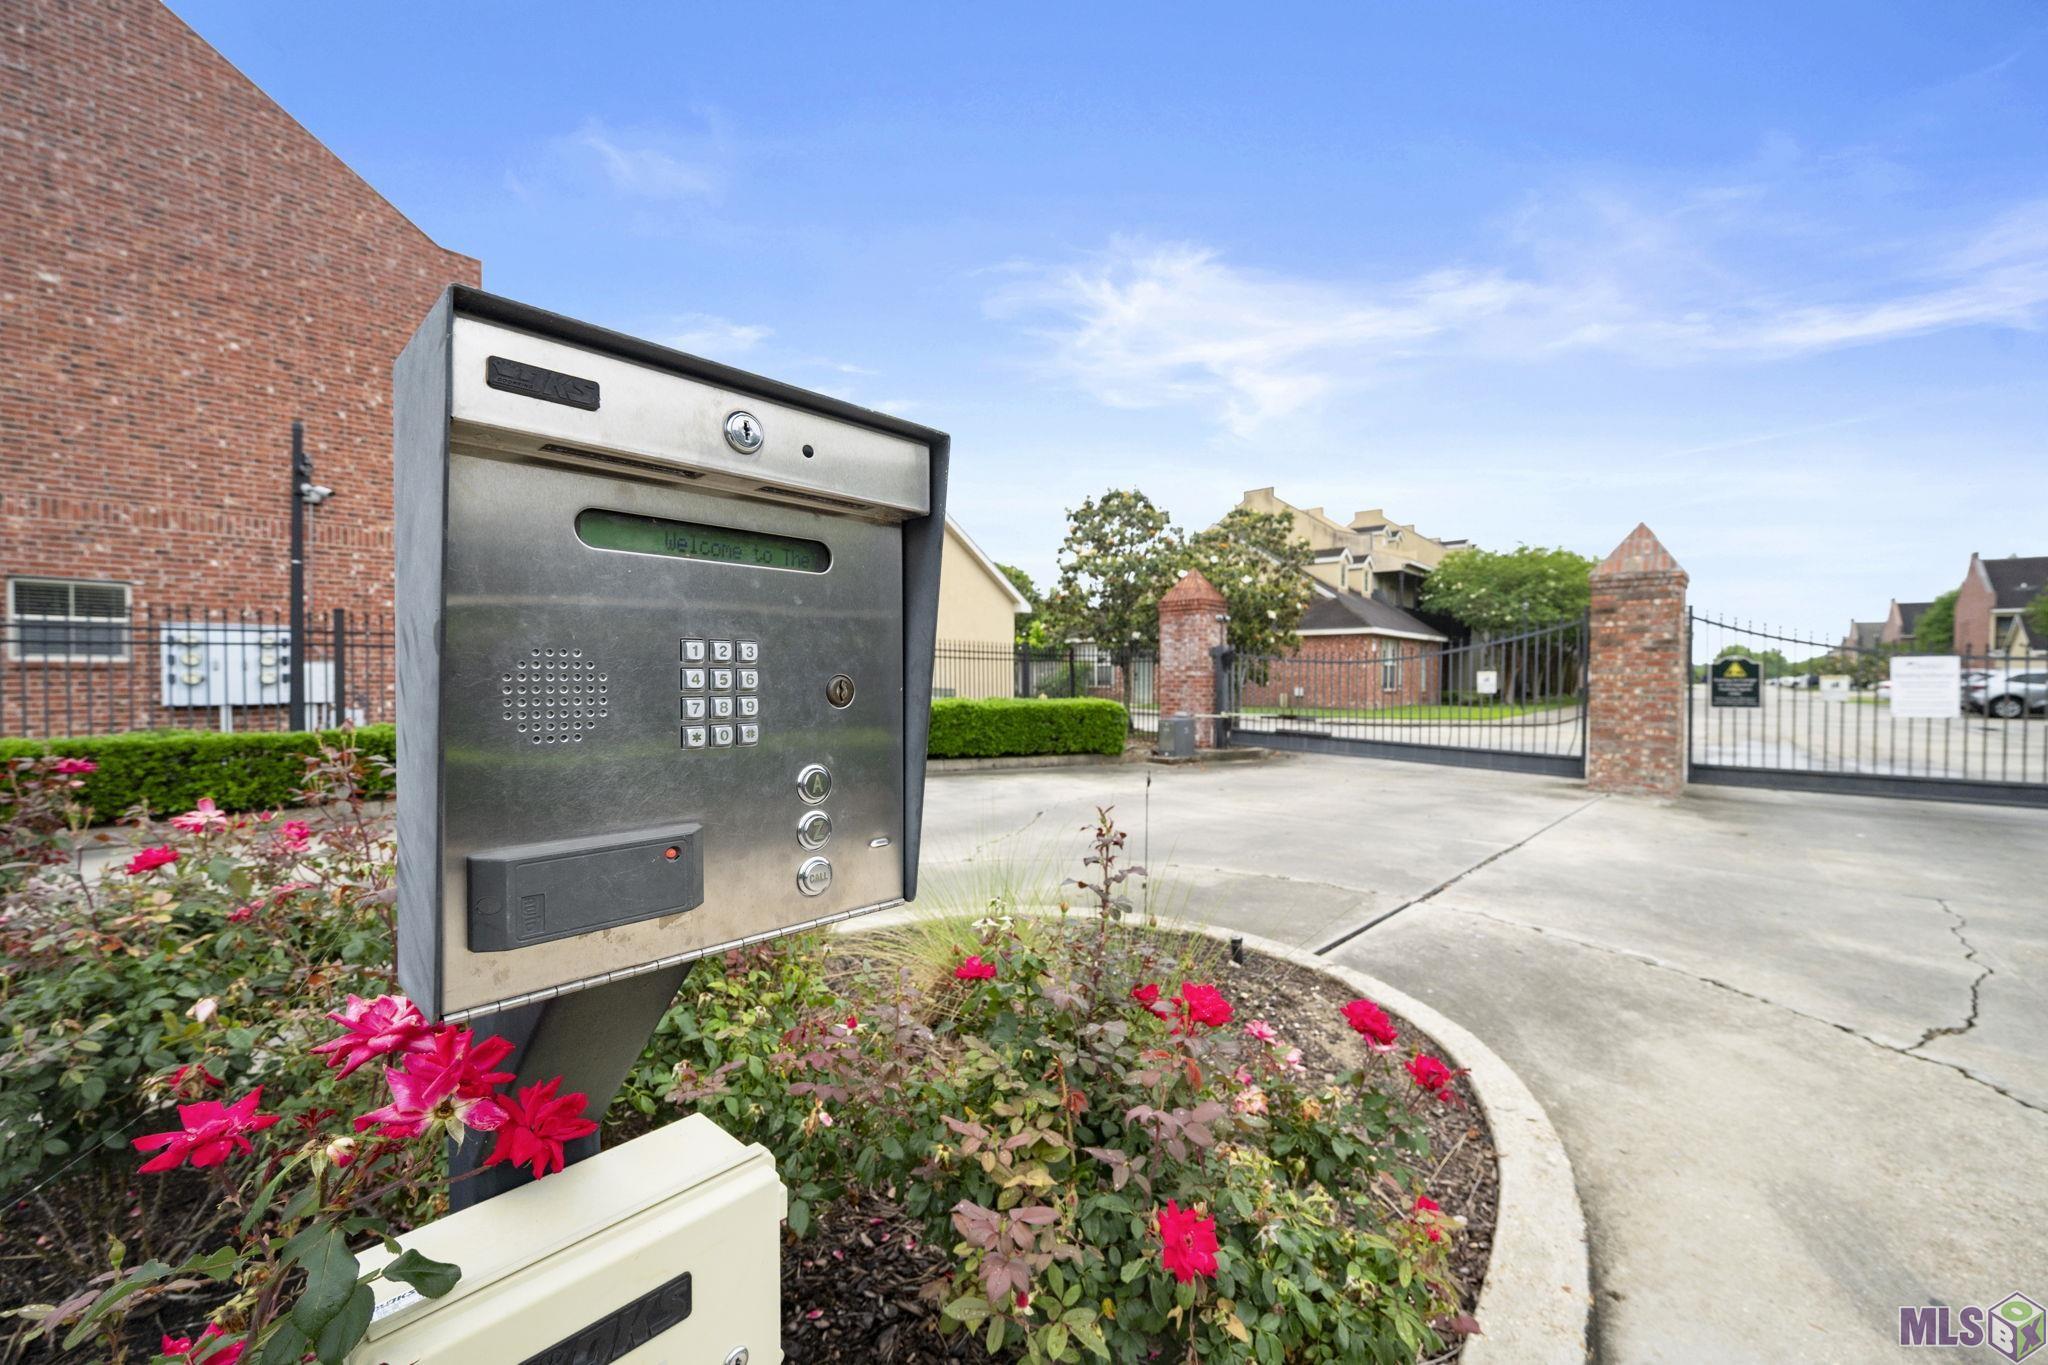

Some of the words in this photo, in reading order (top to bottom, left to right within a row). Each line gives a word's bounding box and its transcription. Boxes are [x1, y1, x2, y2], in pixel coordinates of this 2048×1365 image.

[664, 529, 743, 561] Welcome
[754, 544, 773, 565] to
[783, 547, 811, 570] The
[692, 645, 699, 657] 1
[719, 645, 728, 658] 2
[746, 646, 754, 658] 3
[691, 673, 701, 685] 4
[719, 674, 728, 686] 5
[746, 673, 755, 686] 6
[692, 702, 701, 715] 7
[719, 701, 729, 714] 8
[746, 700, 755, 713] 9
[720, 729, 729, 742] 0
[812, 773, 823, 793] A
[813, 820, 825, 840] Z
[809, 871, 828, 884] CALL
